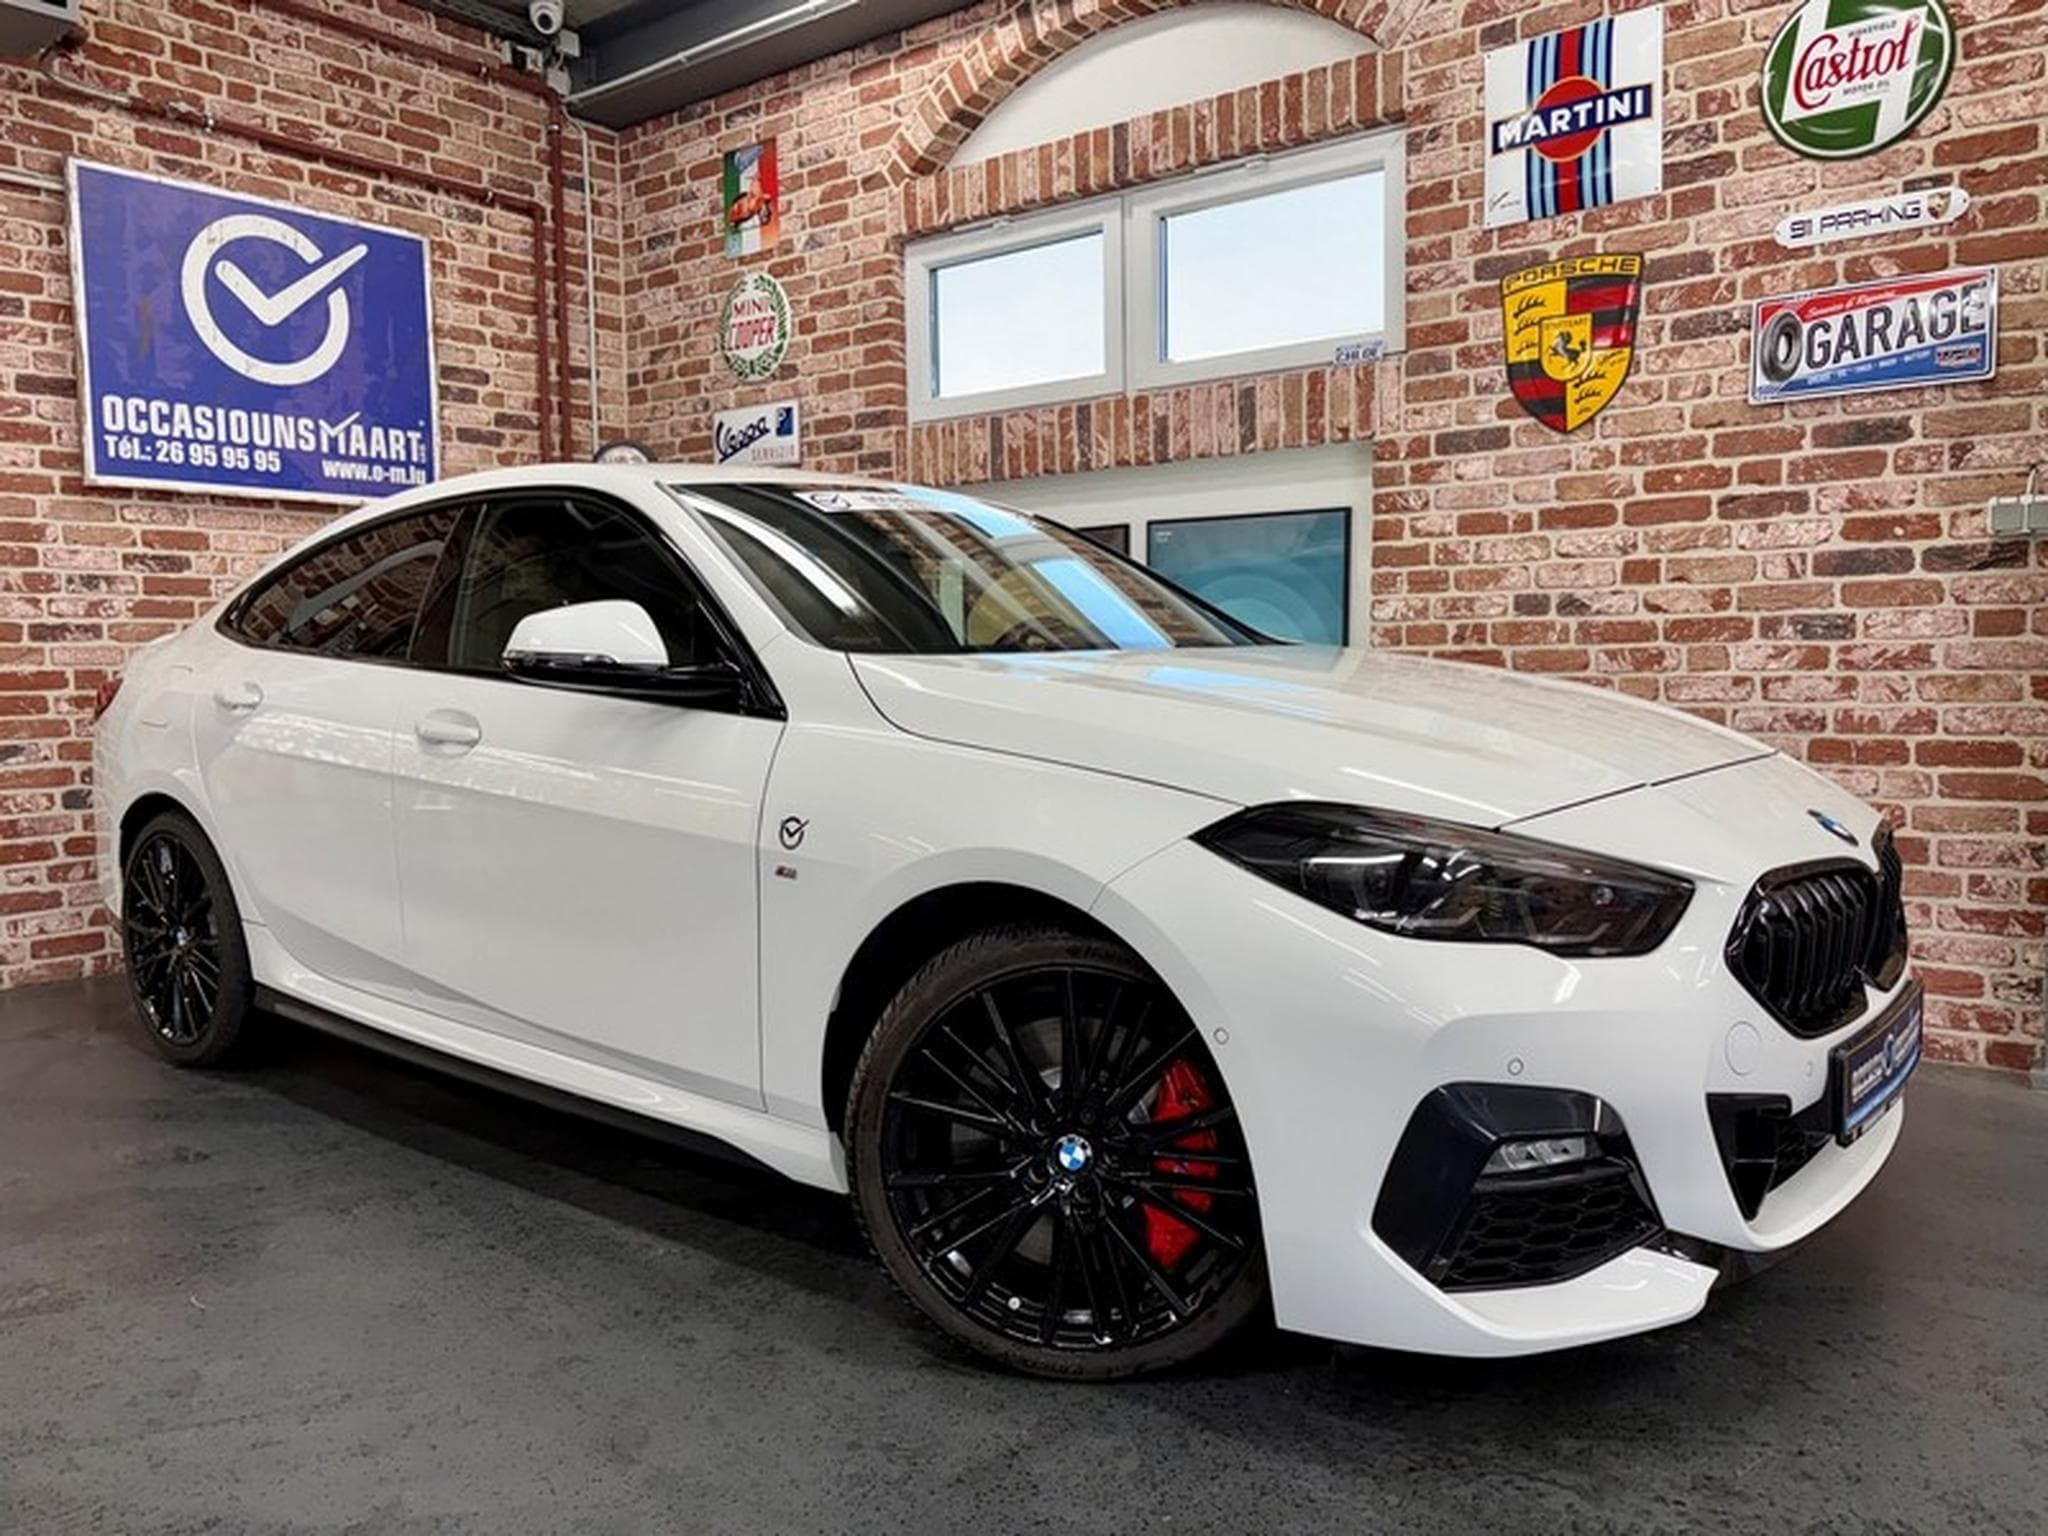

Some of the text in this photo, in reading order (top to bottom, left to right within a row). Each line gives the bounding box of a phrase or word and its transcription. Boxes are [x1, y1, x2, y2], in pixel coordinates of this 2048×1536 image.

[1794, 19, 1919, 110] Castrol
[1499, 89, 1644, 148] MARTINI
[1820, 200, 1921, 233] PARKING
[1505, 257, 1638, 291] PORSCHE
[728, 315, 775, 352] COOPER
[1805, 283, 1987, 369] GARAGE
[102, 394, 421, 464] OCCASIOUNSMAART
[717, 416, 770, 463] Vespa
[155, 440, 184, 464] 26
[189, 443, 218, 467] 95
[222, 446, 250, 470] 95
[254, 449, 281, 473] 95
[322, 459, 425, 484] www.o-m.lu
